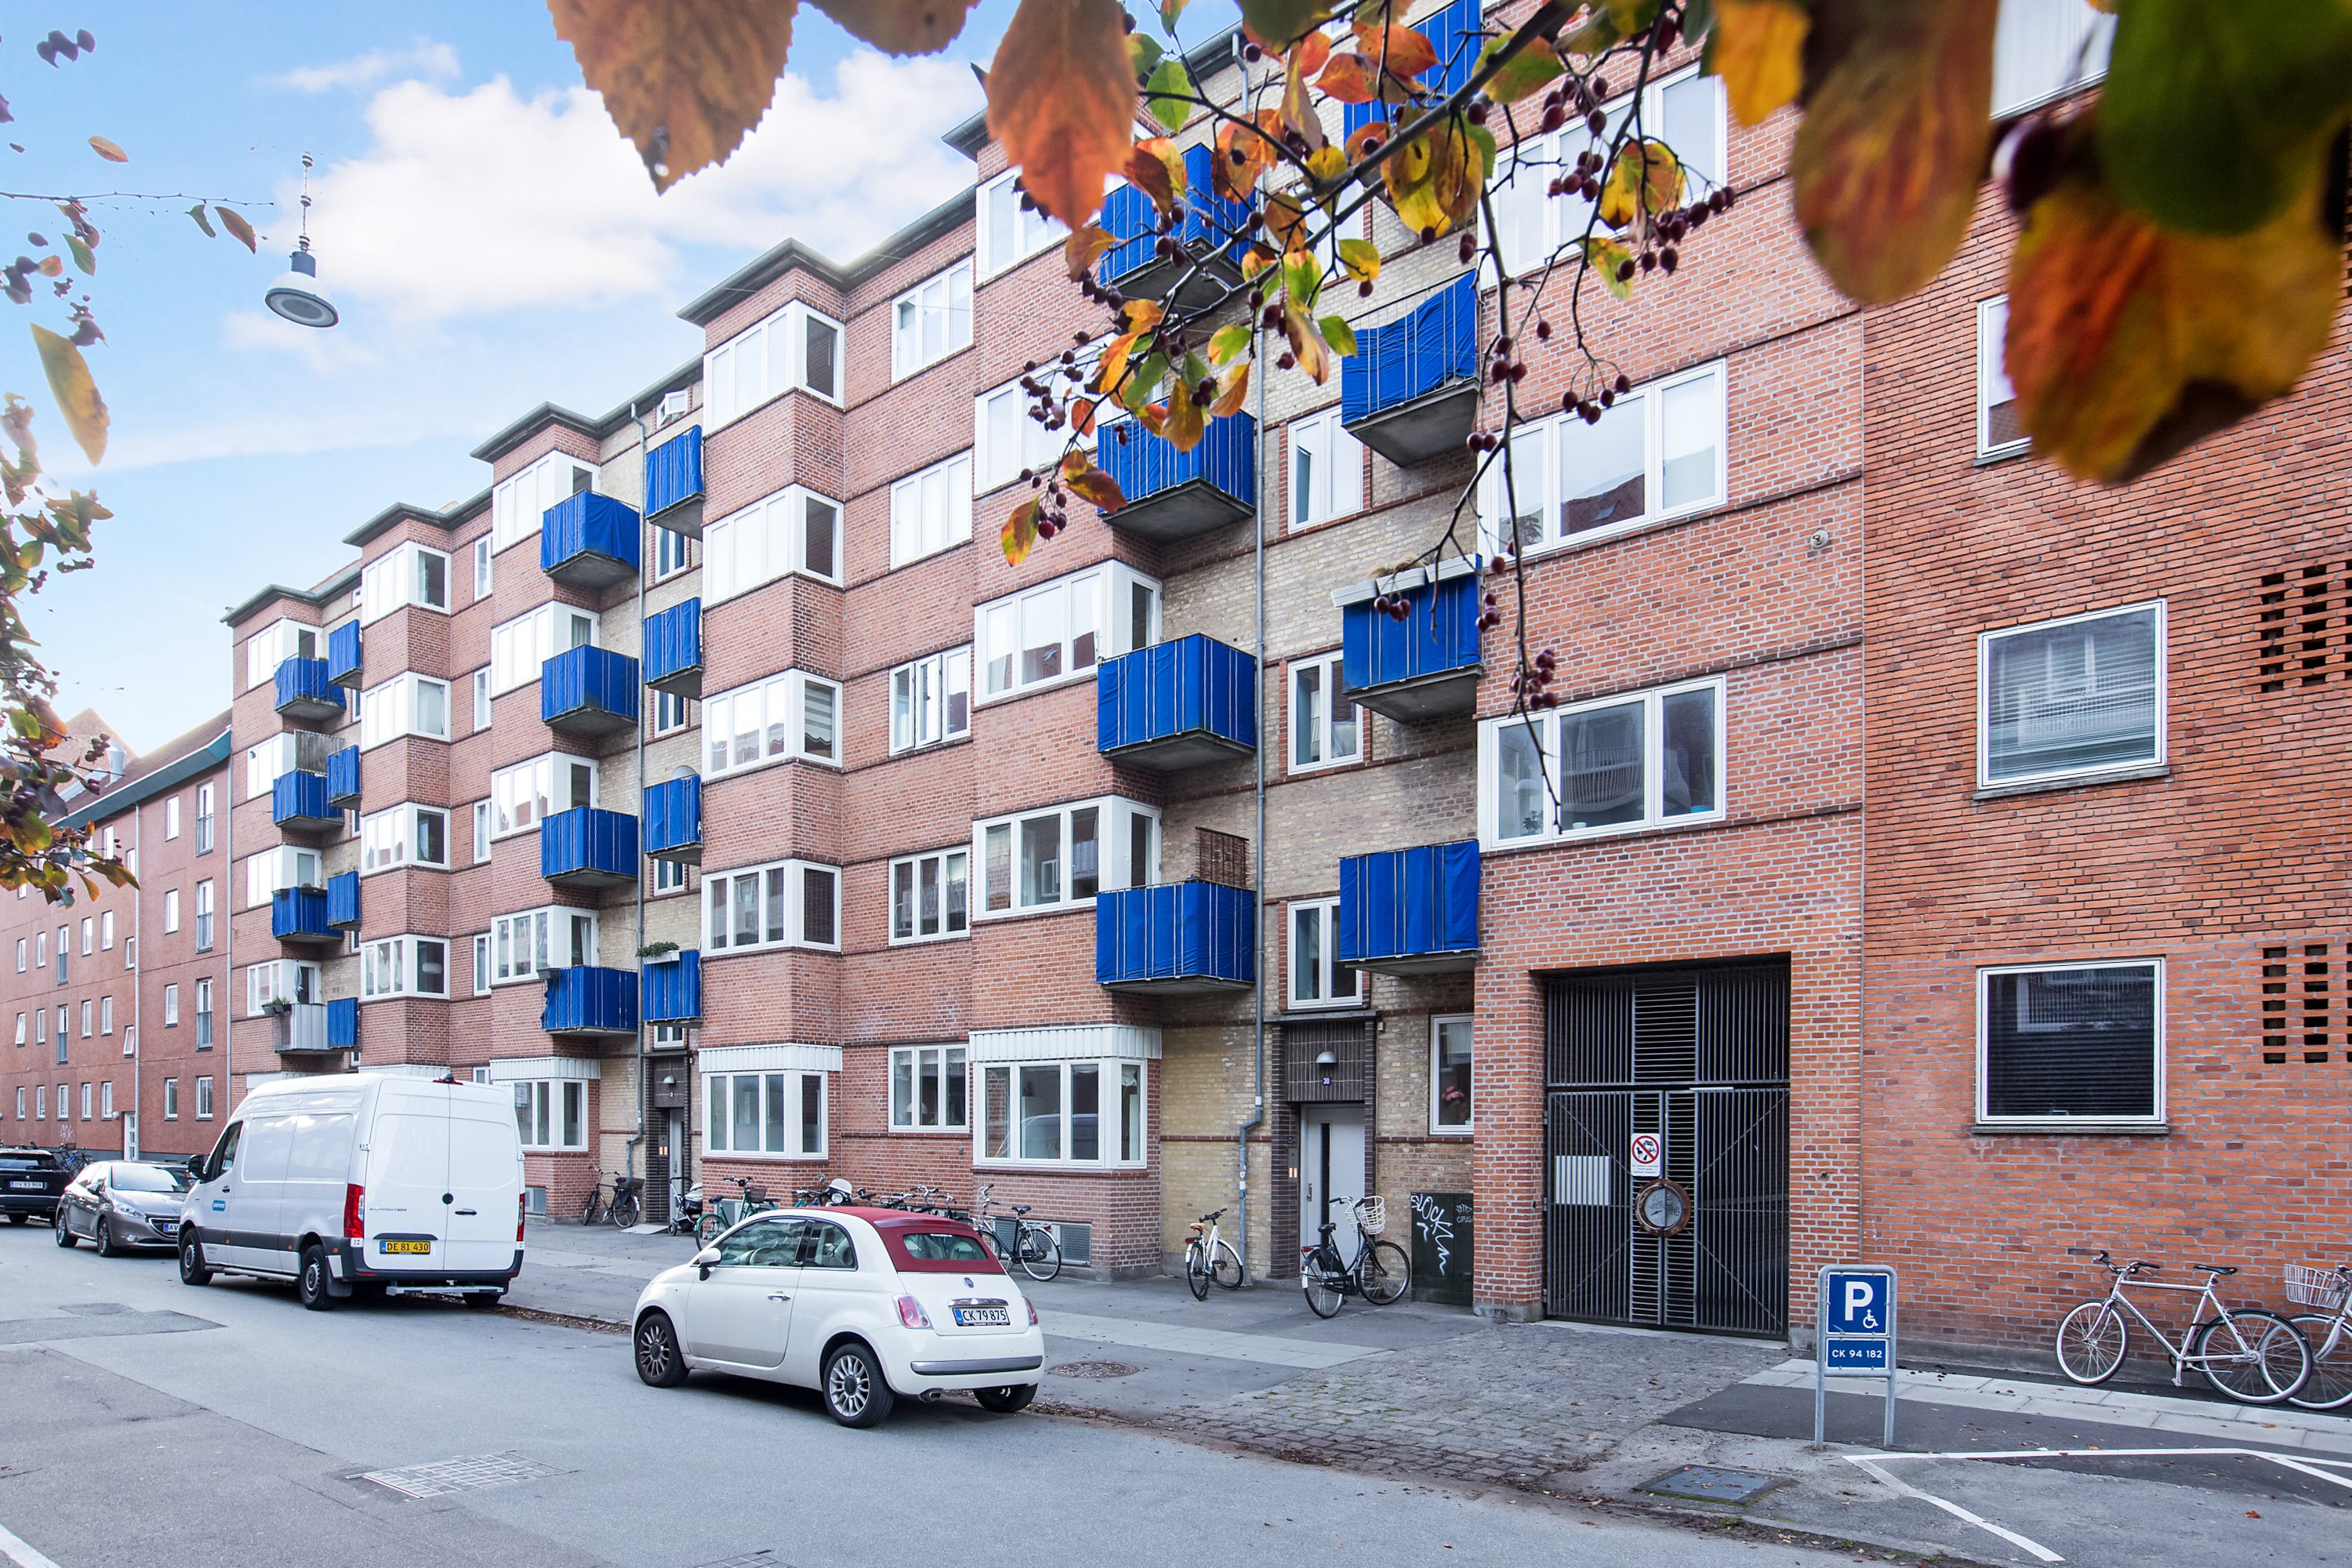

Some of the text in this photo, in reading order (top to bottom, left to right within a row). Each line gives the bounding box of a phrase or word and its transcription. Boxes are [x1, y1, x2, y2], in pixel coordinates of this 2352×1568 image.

[1845, 1281, 1874, 1321] P
[963, 1310, 1007, 1321] CK 79 875
[1831, 1349, 1882, 1359] CK 94 182
